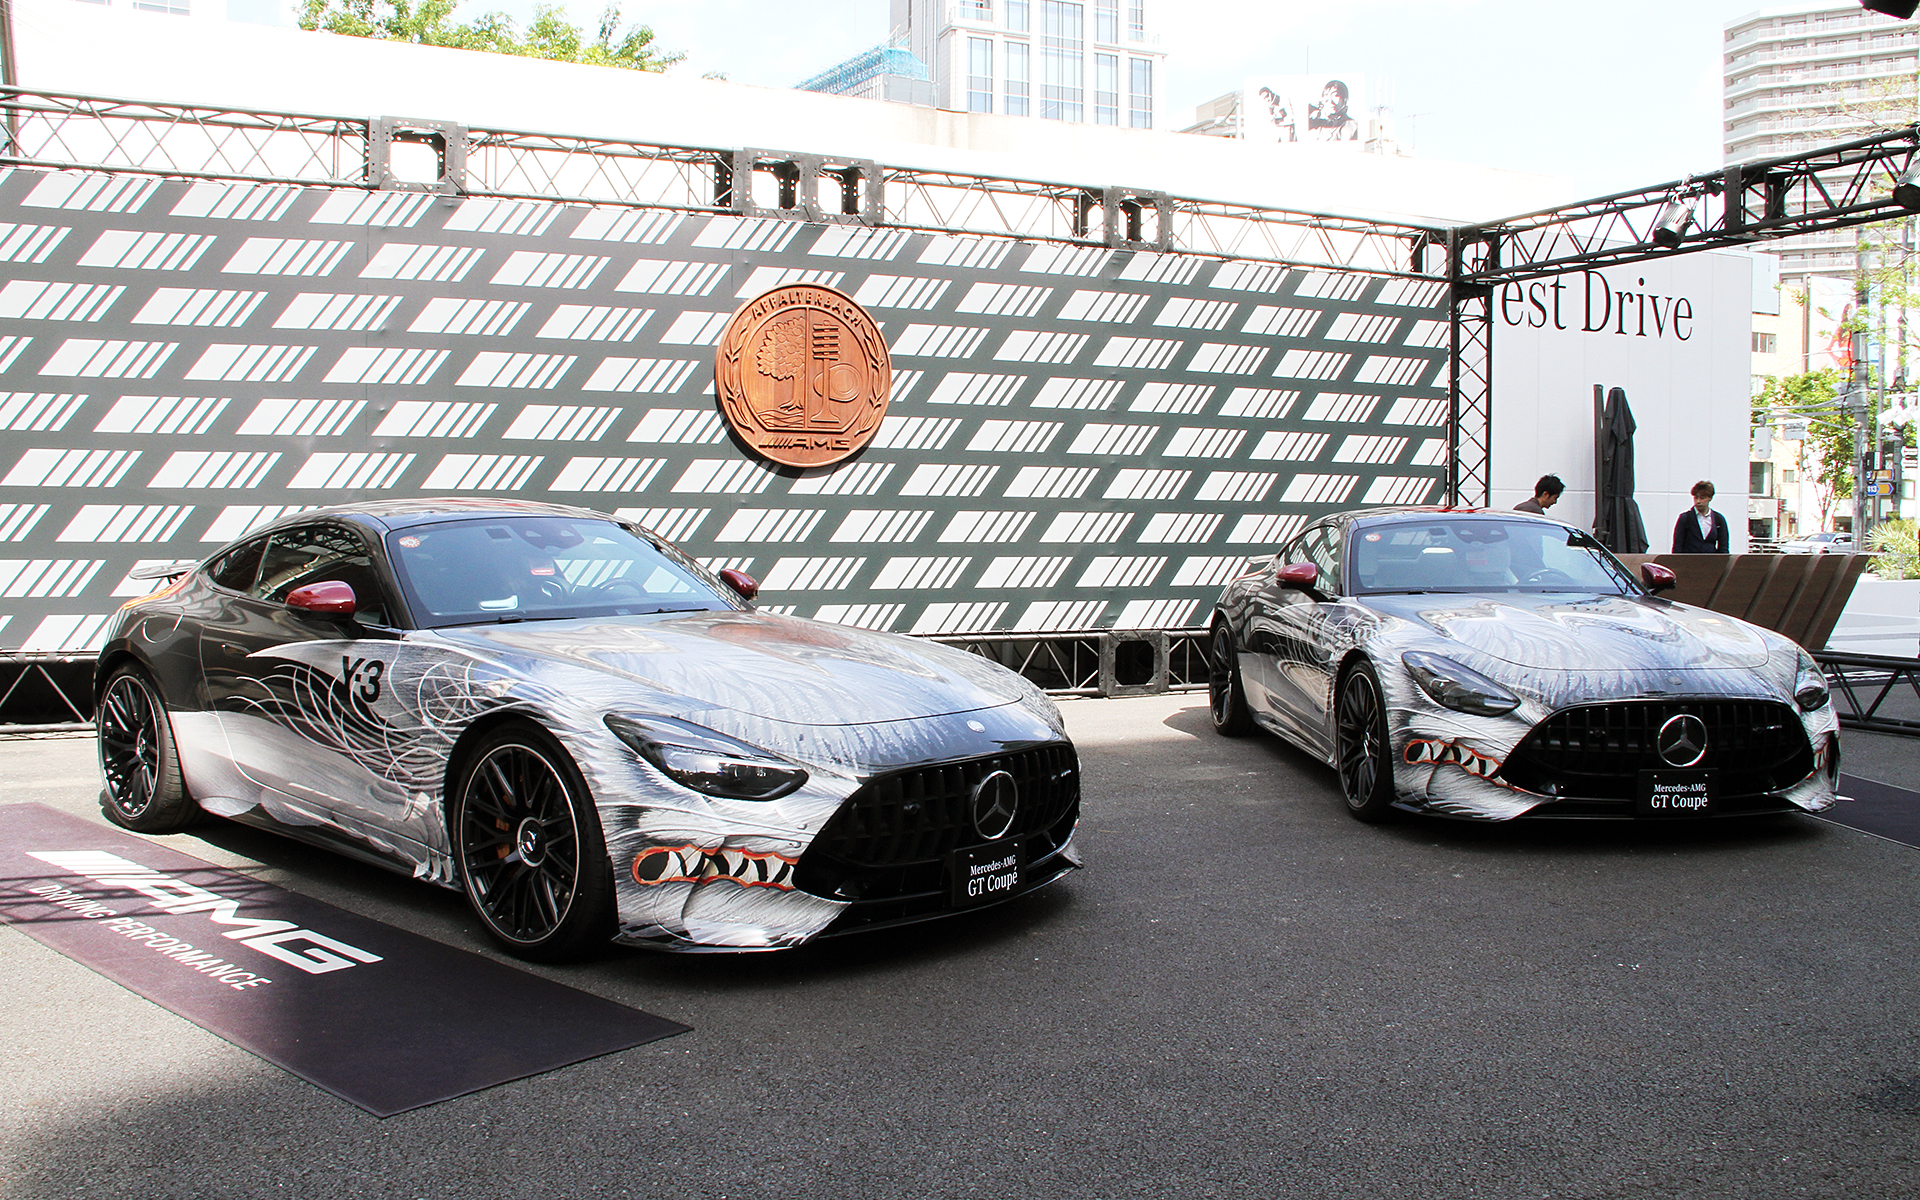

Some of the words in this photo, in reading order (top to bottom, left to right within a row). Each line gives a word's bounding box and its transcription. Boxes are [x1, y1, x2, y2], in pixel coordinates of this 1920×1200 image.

[751, 289, 862, 327] AFFALTERBACH
[1501, 274, 1567, 330] est
[1581, 269, 1693, 341] Drive
[342, 655, 385, 703] Y-3
[1651, 794, 1670, 808] GT
[1671, 792, 1708, 810] Coupé
[1653, 783, 1706, 792] Mercedes-AMG
[968, 876, 985, 897] GT
[987, 865, 1018, 892] Coupé
[970, 854, 1016, 876] Mercedes-AMG
[29, 884, 118, 919] DRIVING
[98, 916, 272, 991] PERFORMANCE
[95, 878, 383, 975] AMG
